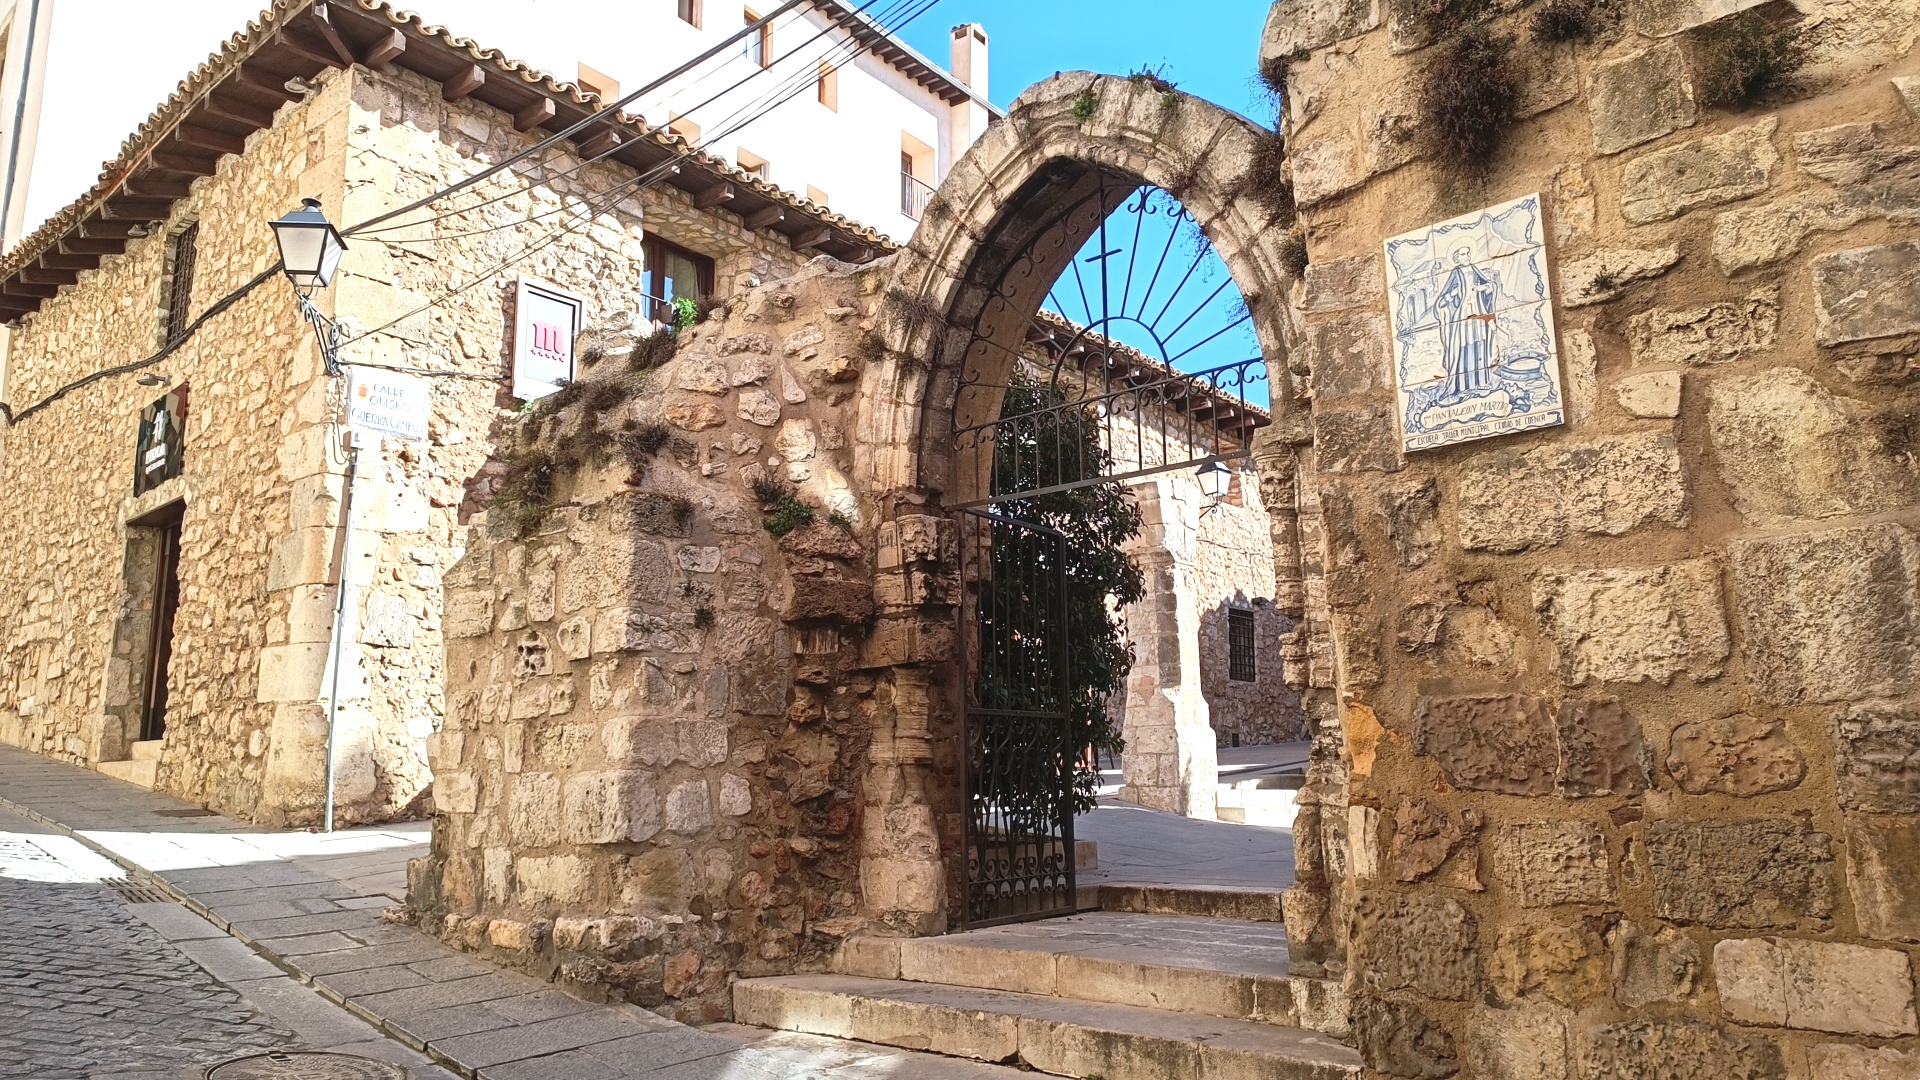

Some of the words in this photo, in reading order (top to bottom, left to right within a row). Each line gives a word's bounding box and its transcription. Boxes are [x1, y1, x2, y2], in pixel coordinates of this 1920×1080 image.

[373, 383, 405, 398] CALLE
[1431, 404, 1478, 424] PANTALEON
[1417, 434, 1439, 446] ESCUELA
[1460, 424, 1491, 437] MUNICIPAL
[1515, 418, 1522, 427] DE
[1524, 413, 1546, 425] CUENCA
